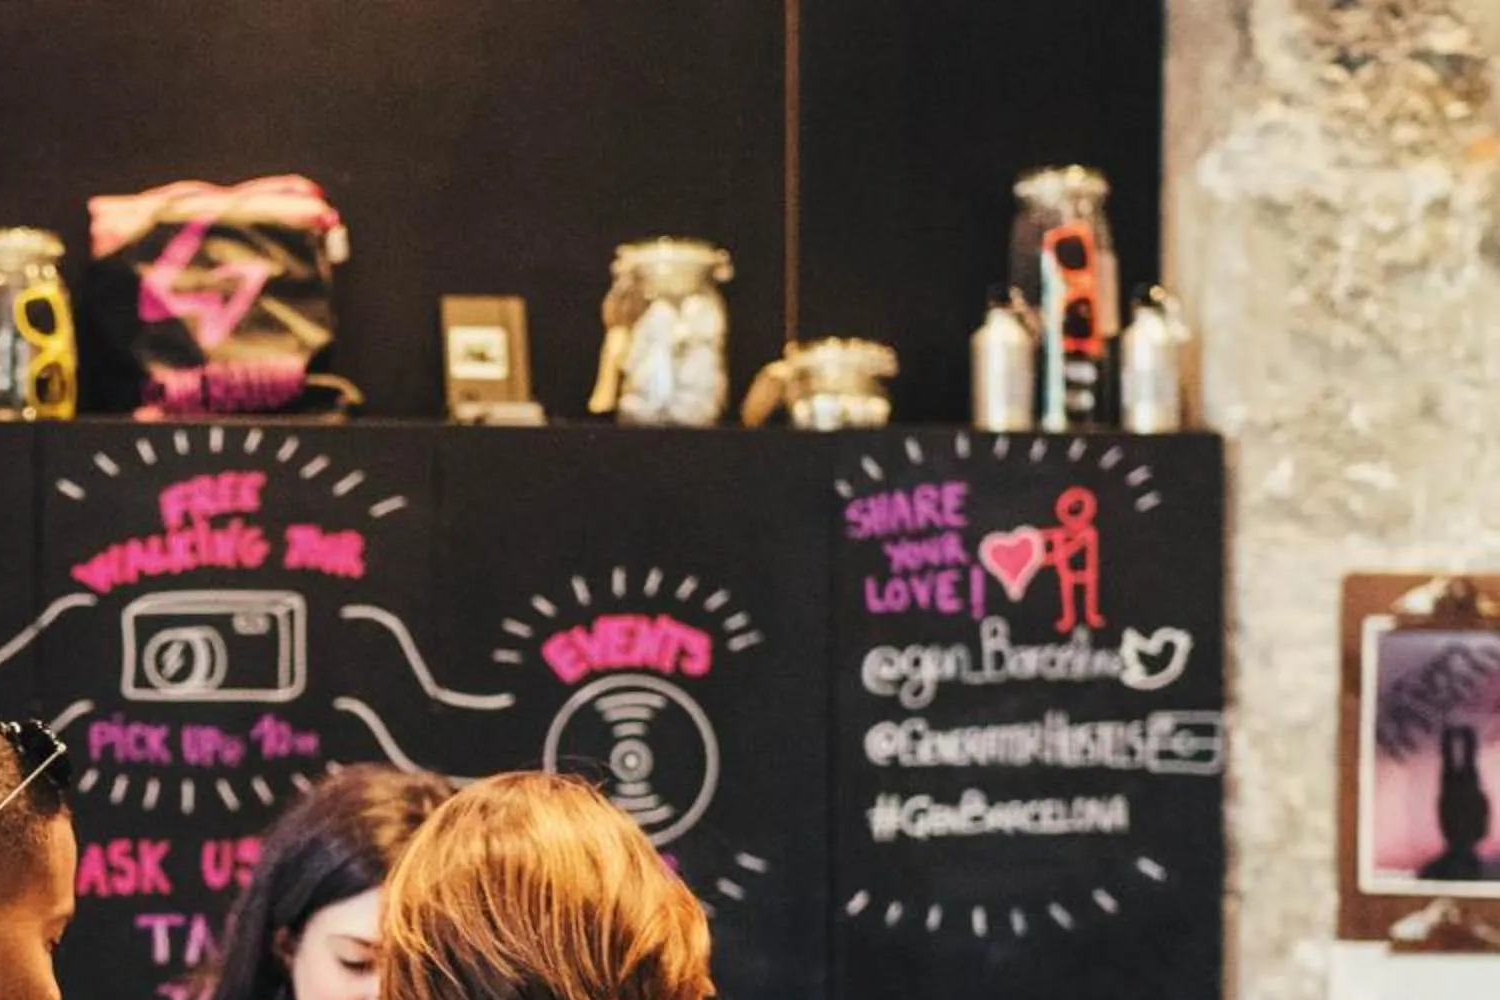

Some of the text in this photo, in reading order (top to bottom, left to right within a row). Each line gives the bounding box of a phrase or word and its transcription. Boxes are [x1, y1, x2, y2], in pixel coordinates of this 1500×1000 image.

[159, 470, 267, 528] FREE
[845, 480, 968, 540] SHARE
[542, 612, 713, 685] EVENTS
[78, 836, 171, 897] ASK
